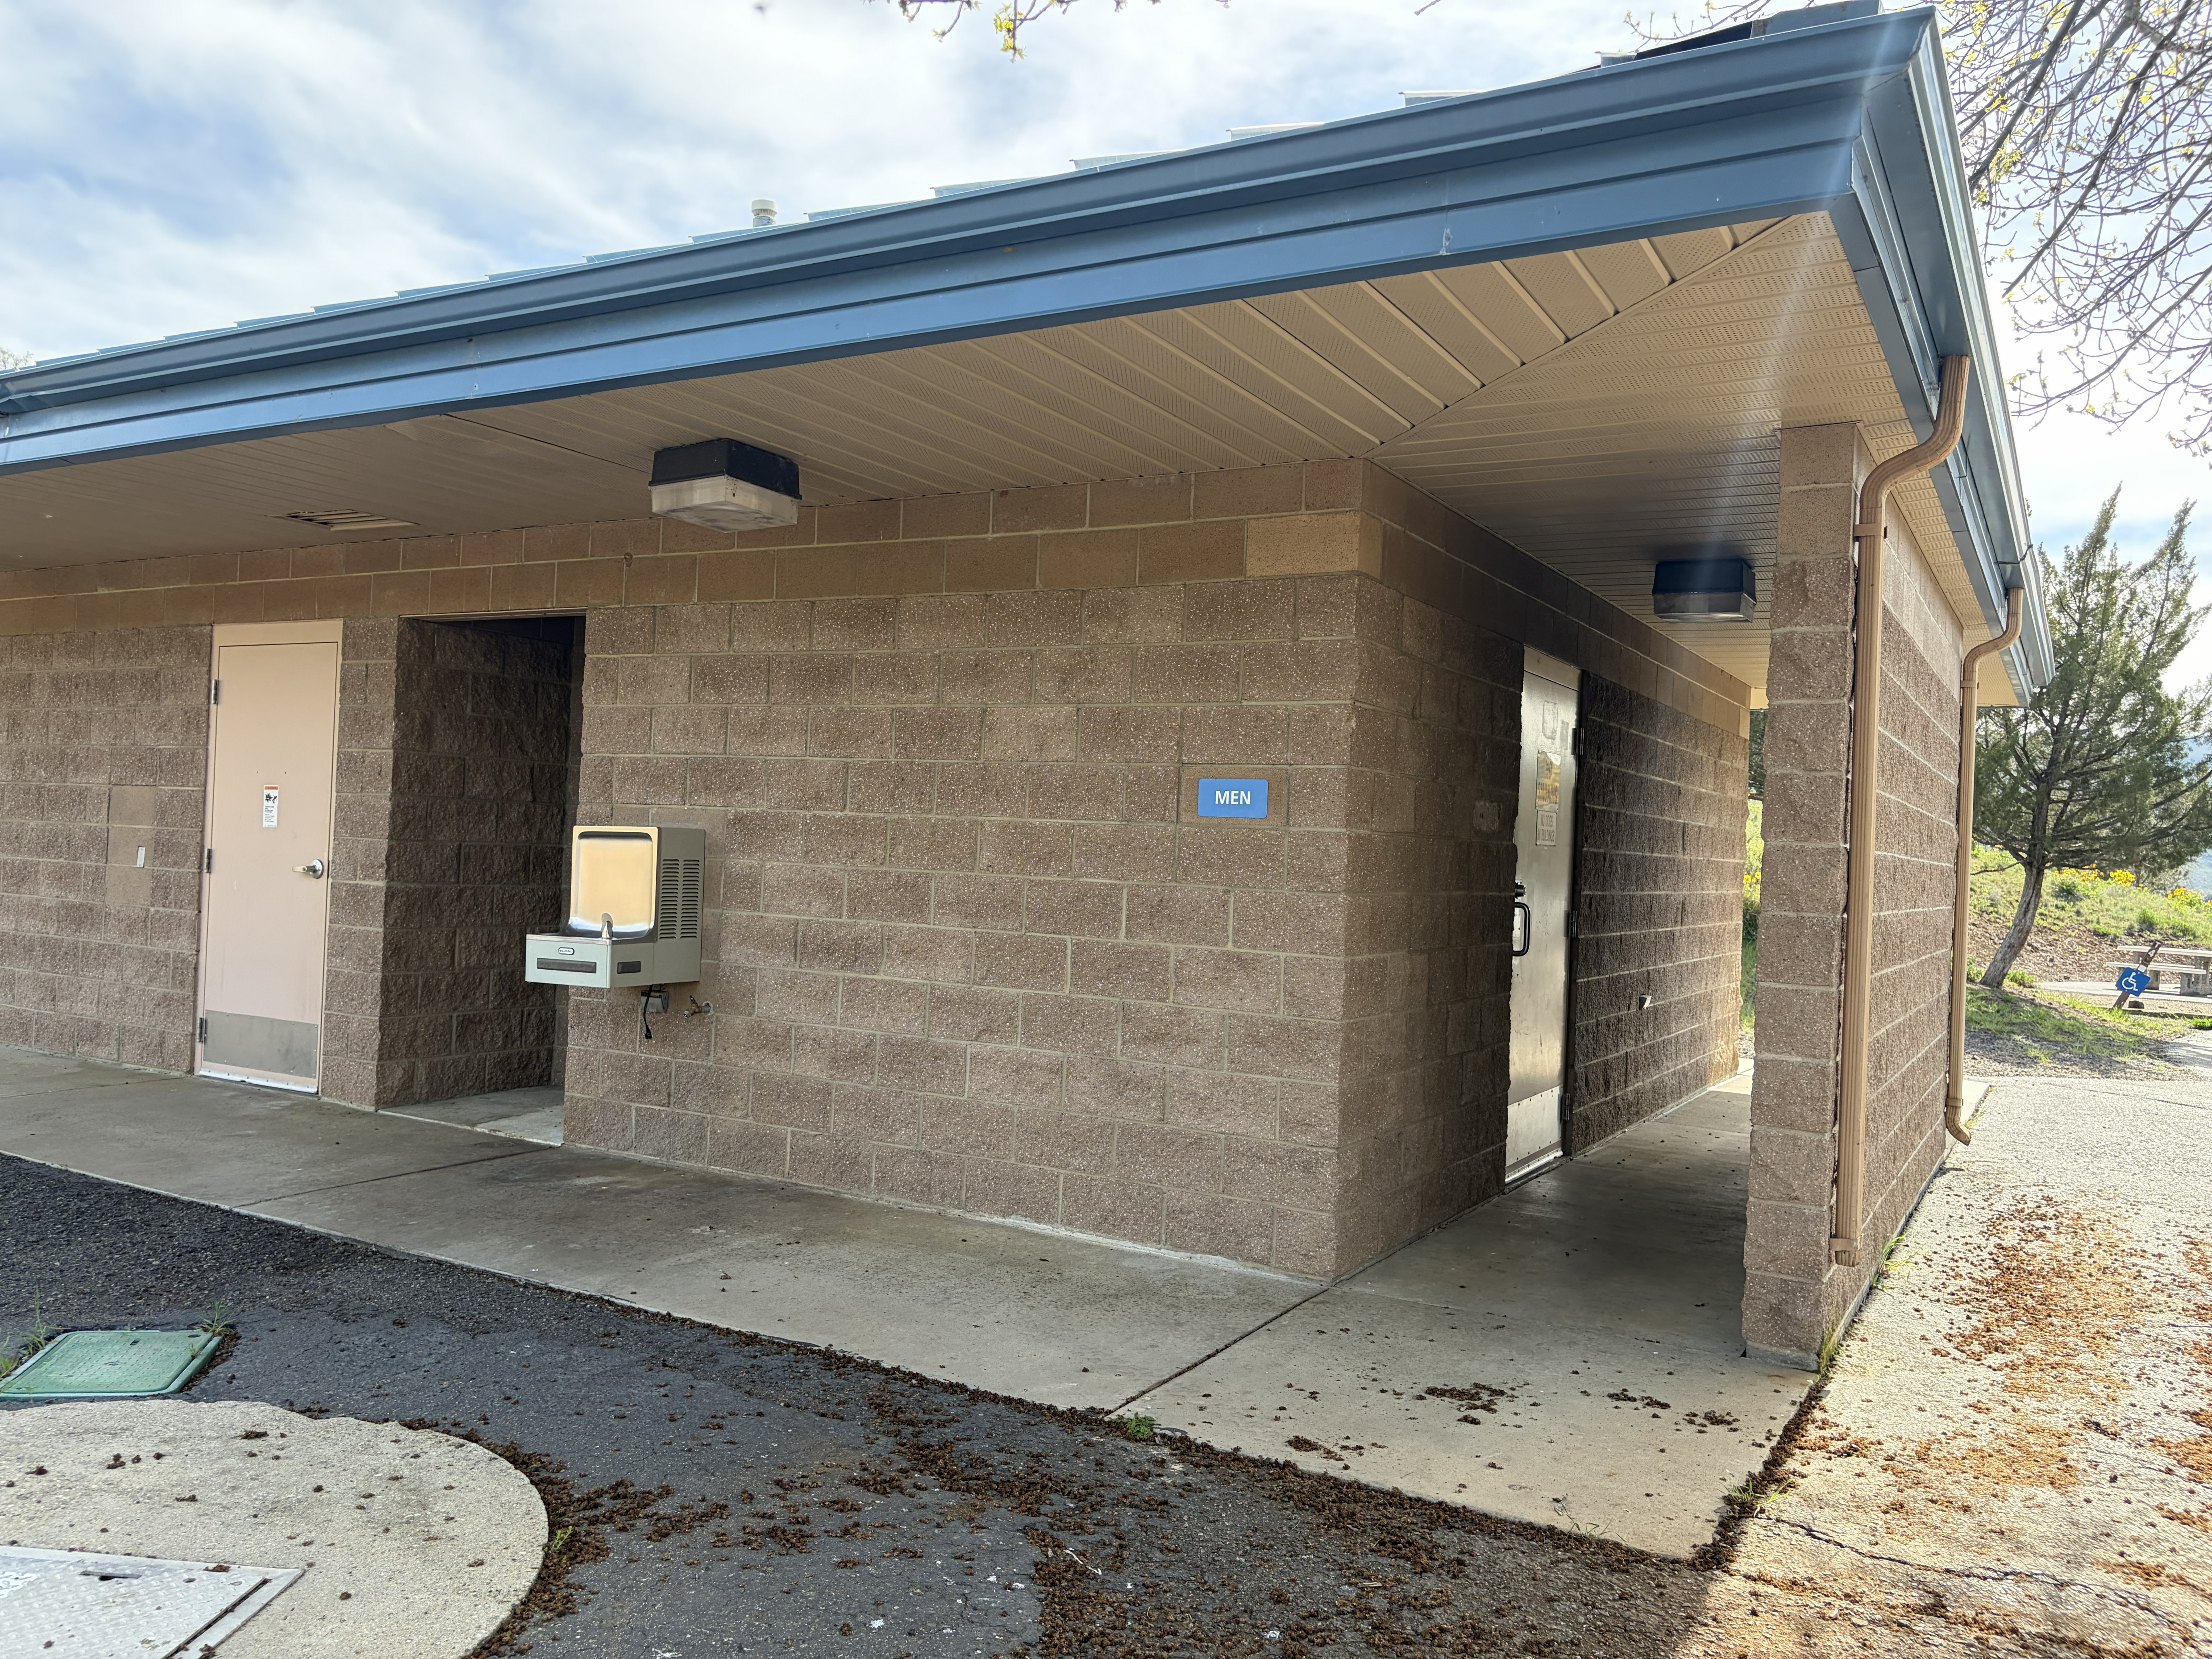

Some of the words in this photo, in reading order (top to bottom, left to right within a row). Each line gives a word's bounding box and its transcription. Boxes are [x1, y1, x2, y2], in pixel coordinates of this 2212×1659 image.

[1546, 760, 1553, 780] NO
[1215, 790, 1251, 805] MEN
[1537, 782, 1558, 804] SMOKING
